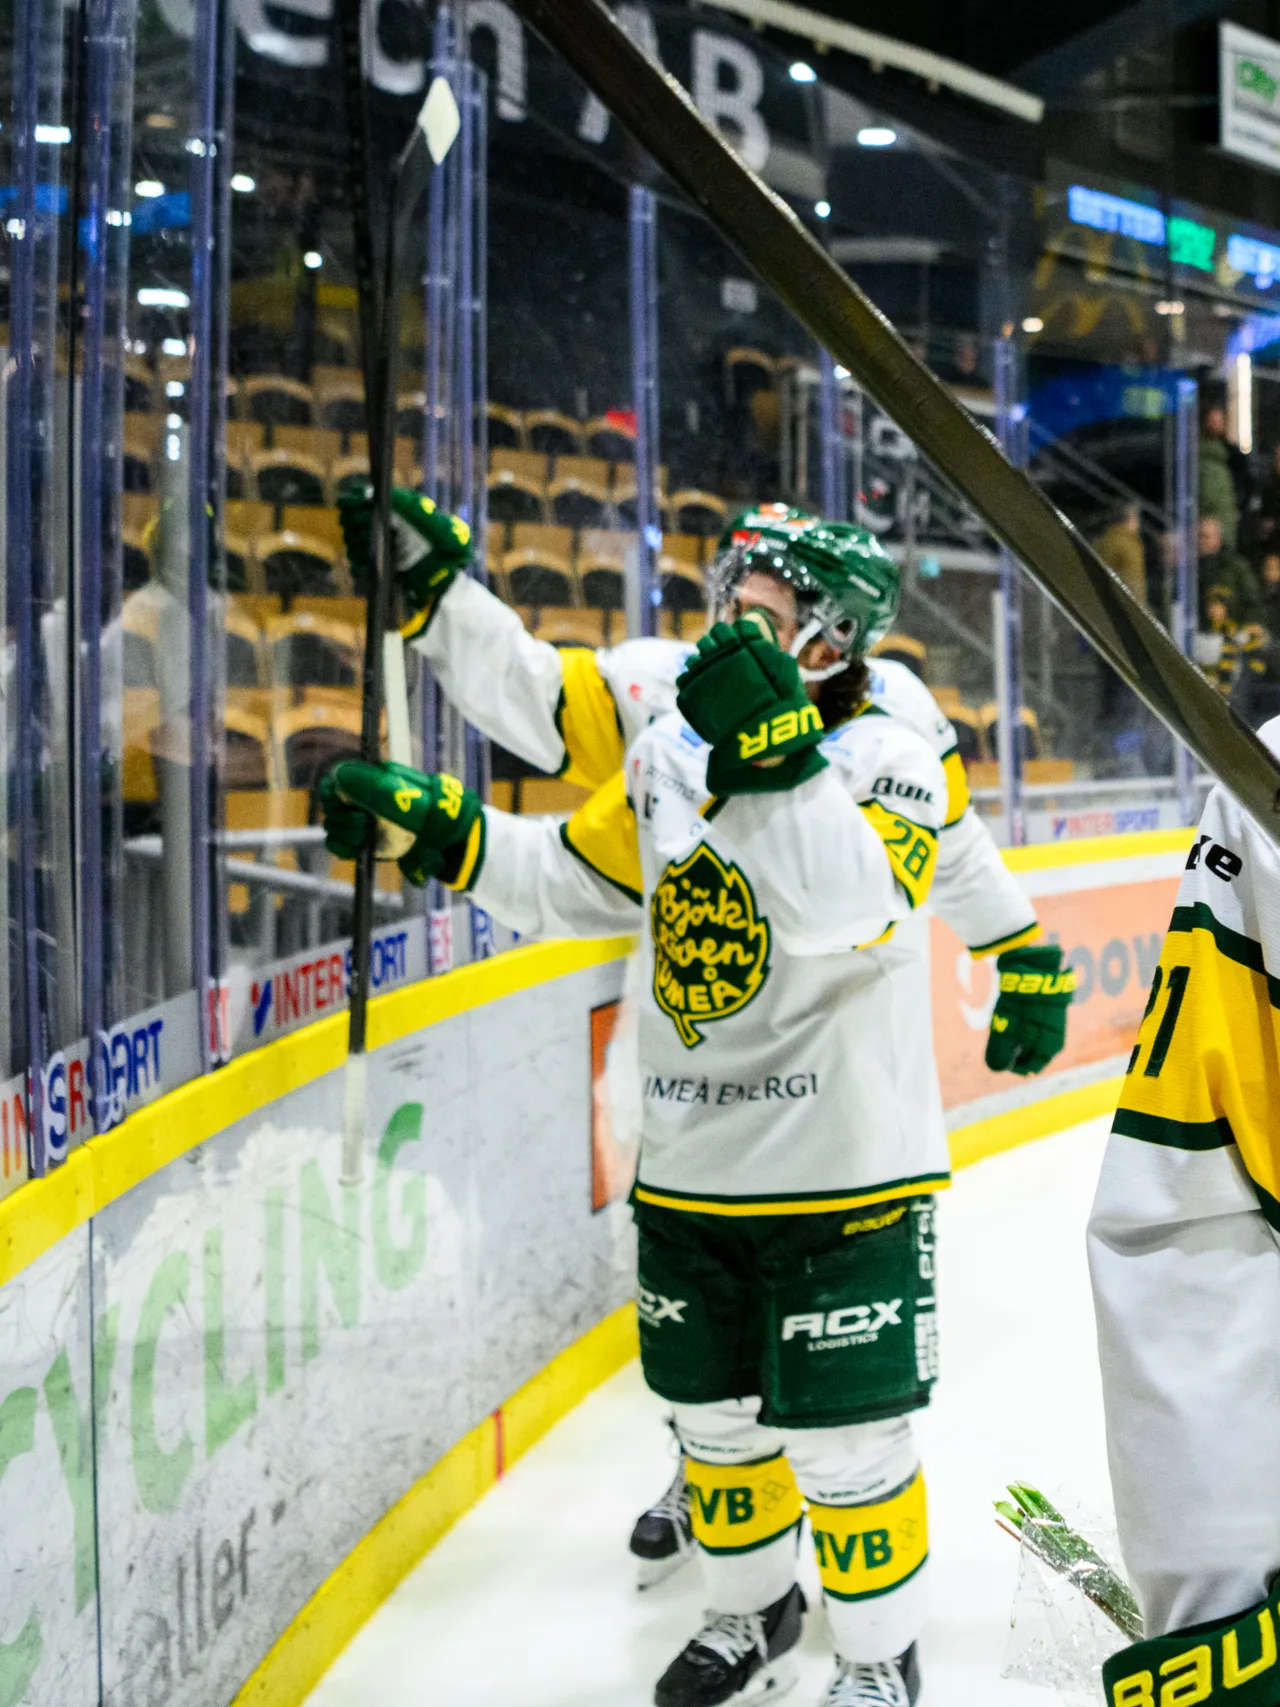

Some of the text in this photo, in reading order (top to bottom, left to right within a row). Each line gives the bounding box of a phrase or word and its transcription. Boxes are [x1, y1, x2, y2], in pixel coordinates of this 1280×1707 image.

[883, 819, 931, 881] 28
[275, 931, 408, 1028] INTERORT
[782, 1298, 904, 1341] ACX
